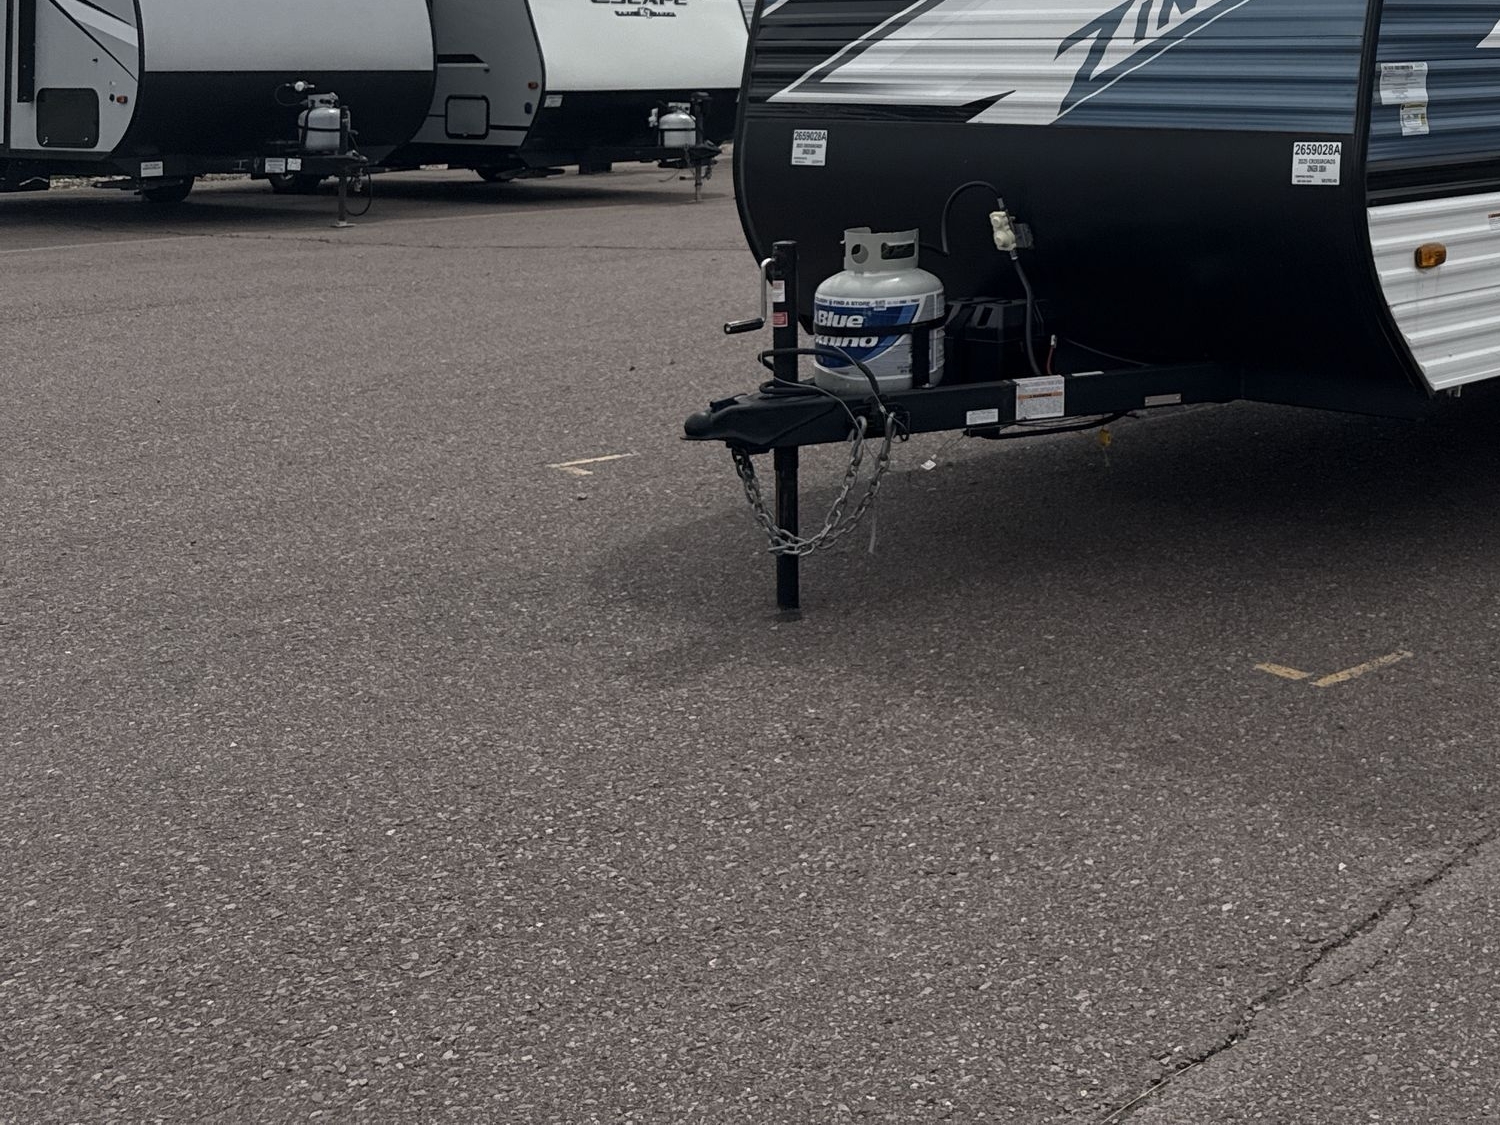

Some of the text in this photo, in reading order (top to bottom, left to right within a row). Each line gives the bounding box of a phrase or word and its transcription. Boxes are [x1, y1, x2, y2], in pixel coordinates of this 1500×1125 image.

[794, 131, 827, 141] 2659028A
[1294, 144, 1341, 155] 2659028A
[816, 309, 864, 328] Blue
